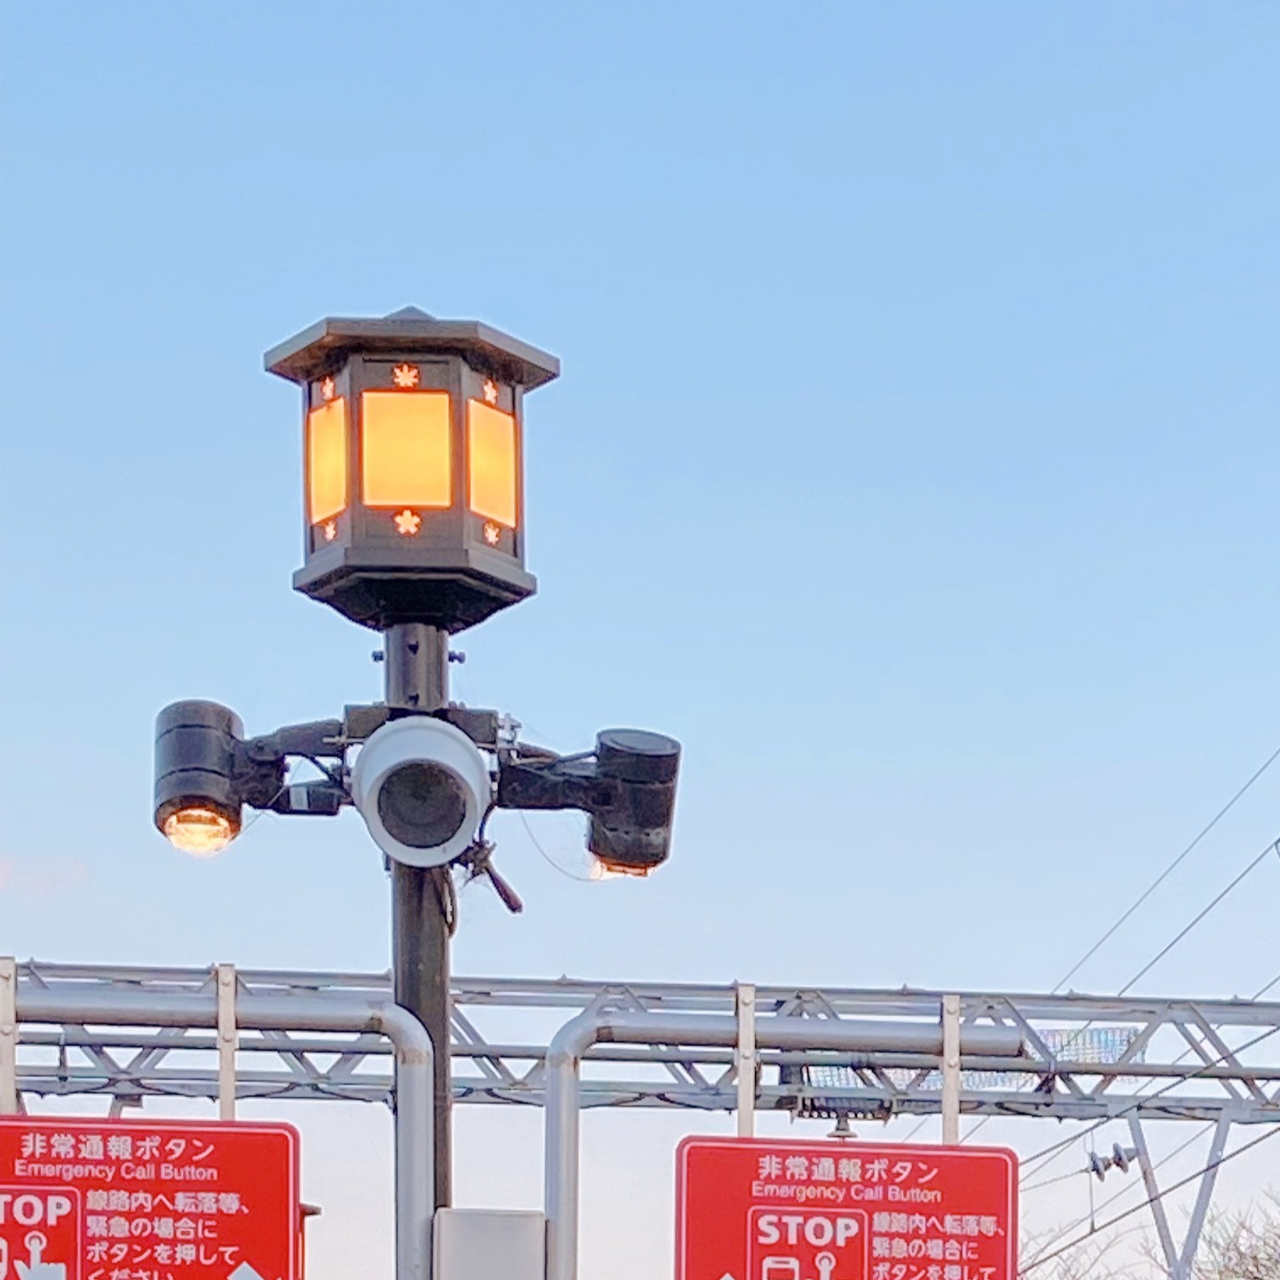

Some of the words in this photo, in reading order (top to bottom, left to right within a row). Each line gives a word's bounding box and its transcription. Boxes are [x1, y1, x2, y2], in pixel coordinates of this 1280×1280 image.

[21, 1133, 215, 1161] 非常通報ボタン
[14, 1160, 116, 1182] Emergency
[120, 1162, 154, 1179] Call
[160, 1164, 218, 1181] Button
[758, 1154, 939, 1183] 非常通報ボタン
[751, 1181, 846, 1203] Emergency
[850, 1184, 883, 1201] Call
[888, 1185, 942, 1203] Button
[86, 1215, 217, 1239] 緊急の場合に
[757, 1214, 859, 1247] STOP
[86, 1240, 240, 1266] ボタンを押して
